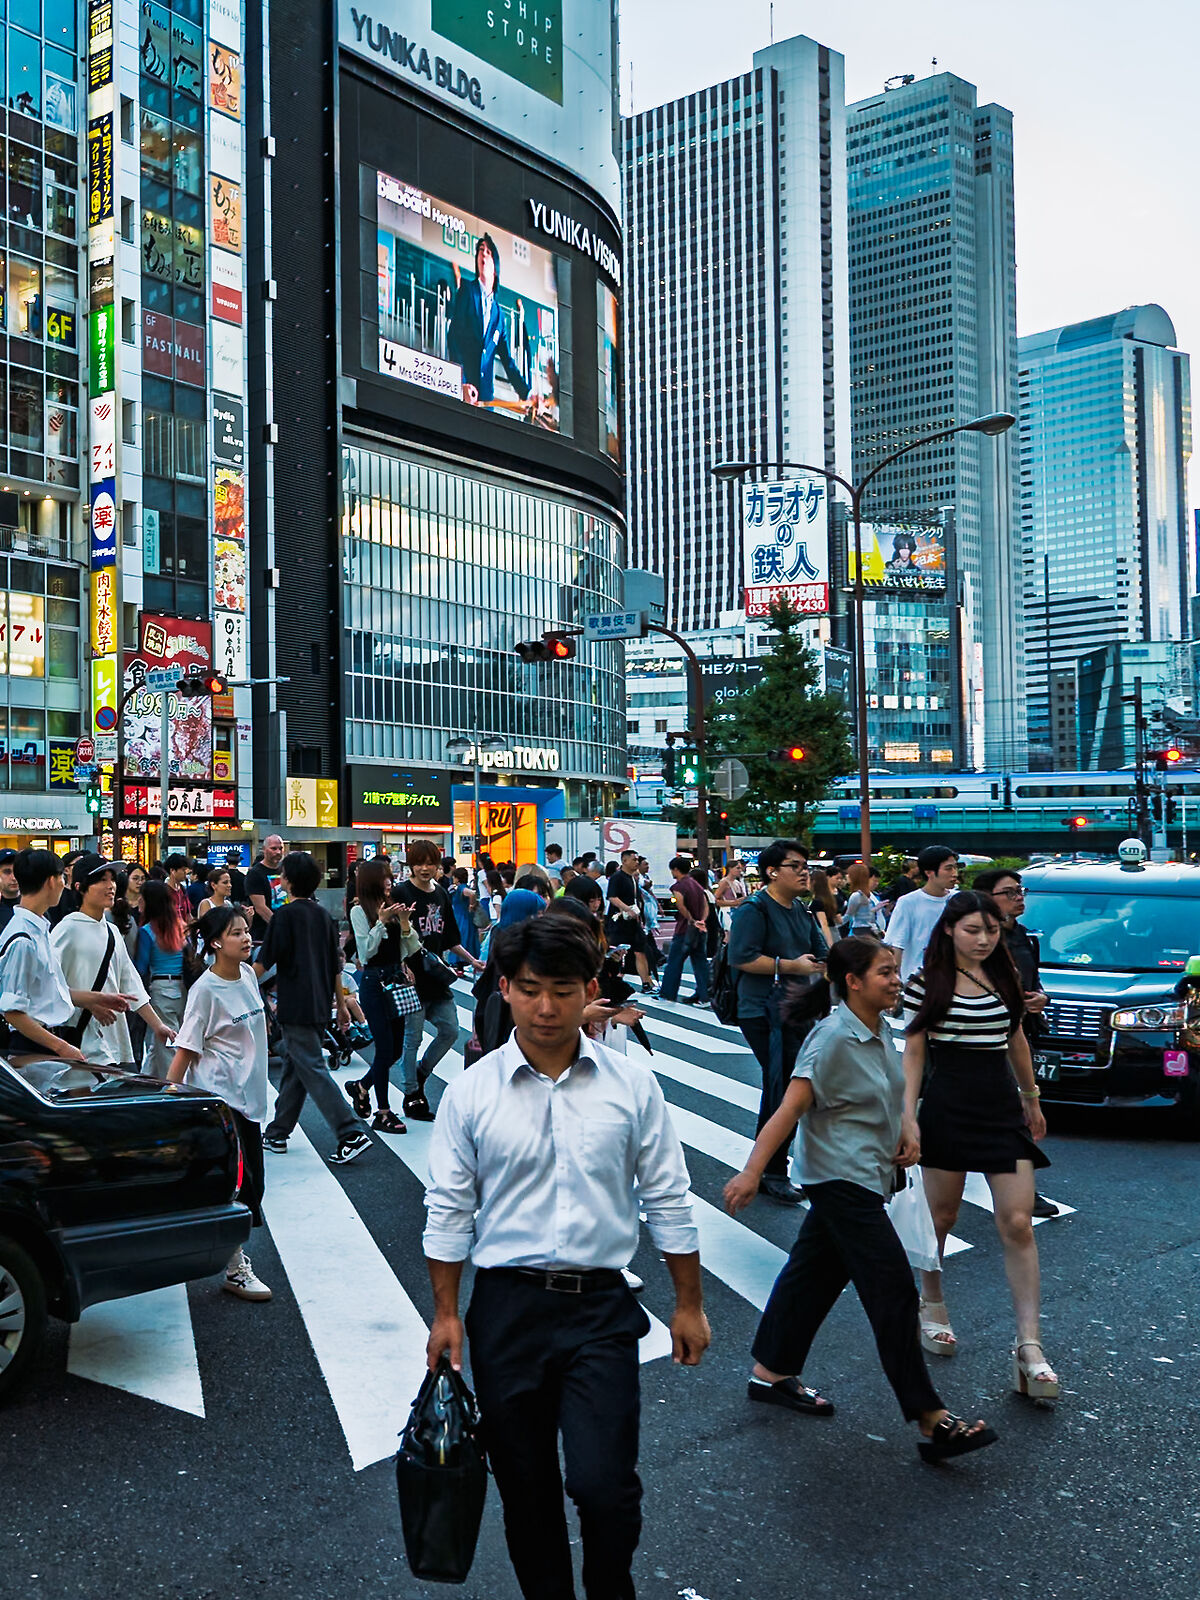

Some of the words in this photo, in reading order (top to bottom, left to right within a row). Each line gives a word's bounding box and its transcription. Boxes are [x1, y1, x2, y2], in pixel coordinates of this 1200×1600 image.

[487, 9, 552, 64] STORE
[351, 7, 432, 80] YUNIKA
[435, 56, 485, 110] BLDG.
[92, 143, 100, 190] クリニック
[377, 174, 432, 218] billboard
[530, 198, 591, 256] YUNIKA
[592, 233, 621, 287] VISION
[48, 313, 72, 339] 6F
[146, 315, 156, 326] 6F
[146, 336, 201, 363] FASTNAIL
[384, 343, 396, 370] 4
[414, 358, 443, 376] ライラック
[95, 506, 112, 527] 薬
[746, 479, 824, 526] カラオケ
[777, 521, 794, 546] の
[751, 542, 819, 584] 鉄人
[98, 573, 111, 651] 肉汁水餃子
[225, 618, 236, 678] 日高屋
[96, 672, 112, 705] レイ
[51, 748, 75, 784] 薬
[462, 746, 514, 771] Alpen
[514, 746, 559, 771] TOKYO
[169, 792, 204, 813] 日高屋
[486, 806, 525, 828] RUN
[4, 817, 62, 830] PANDORA
